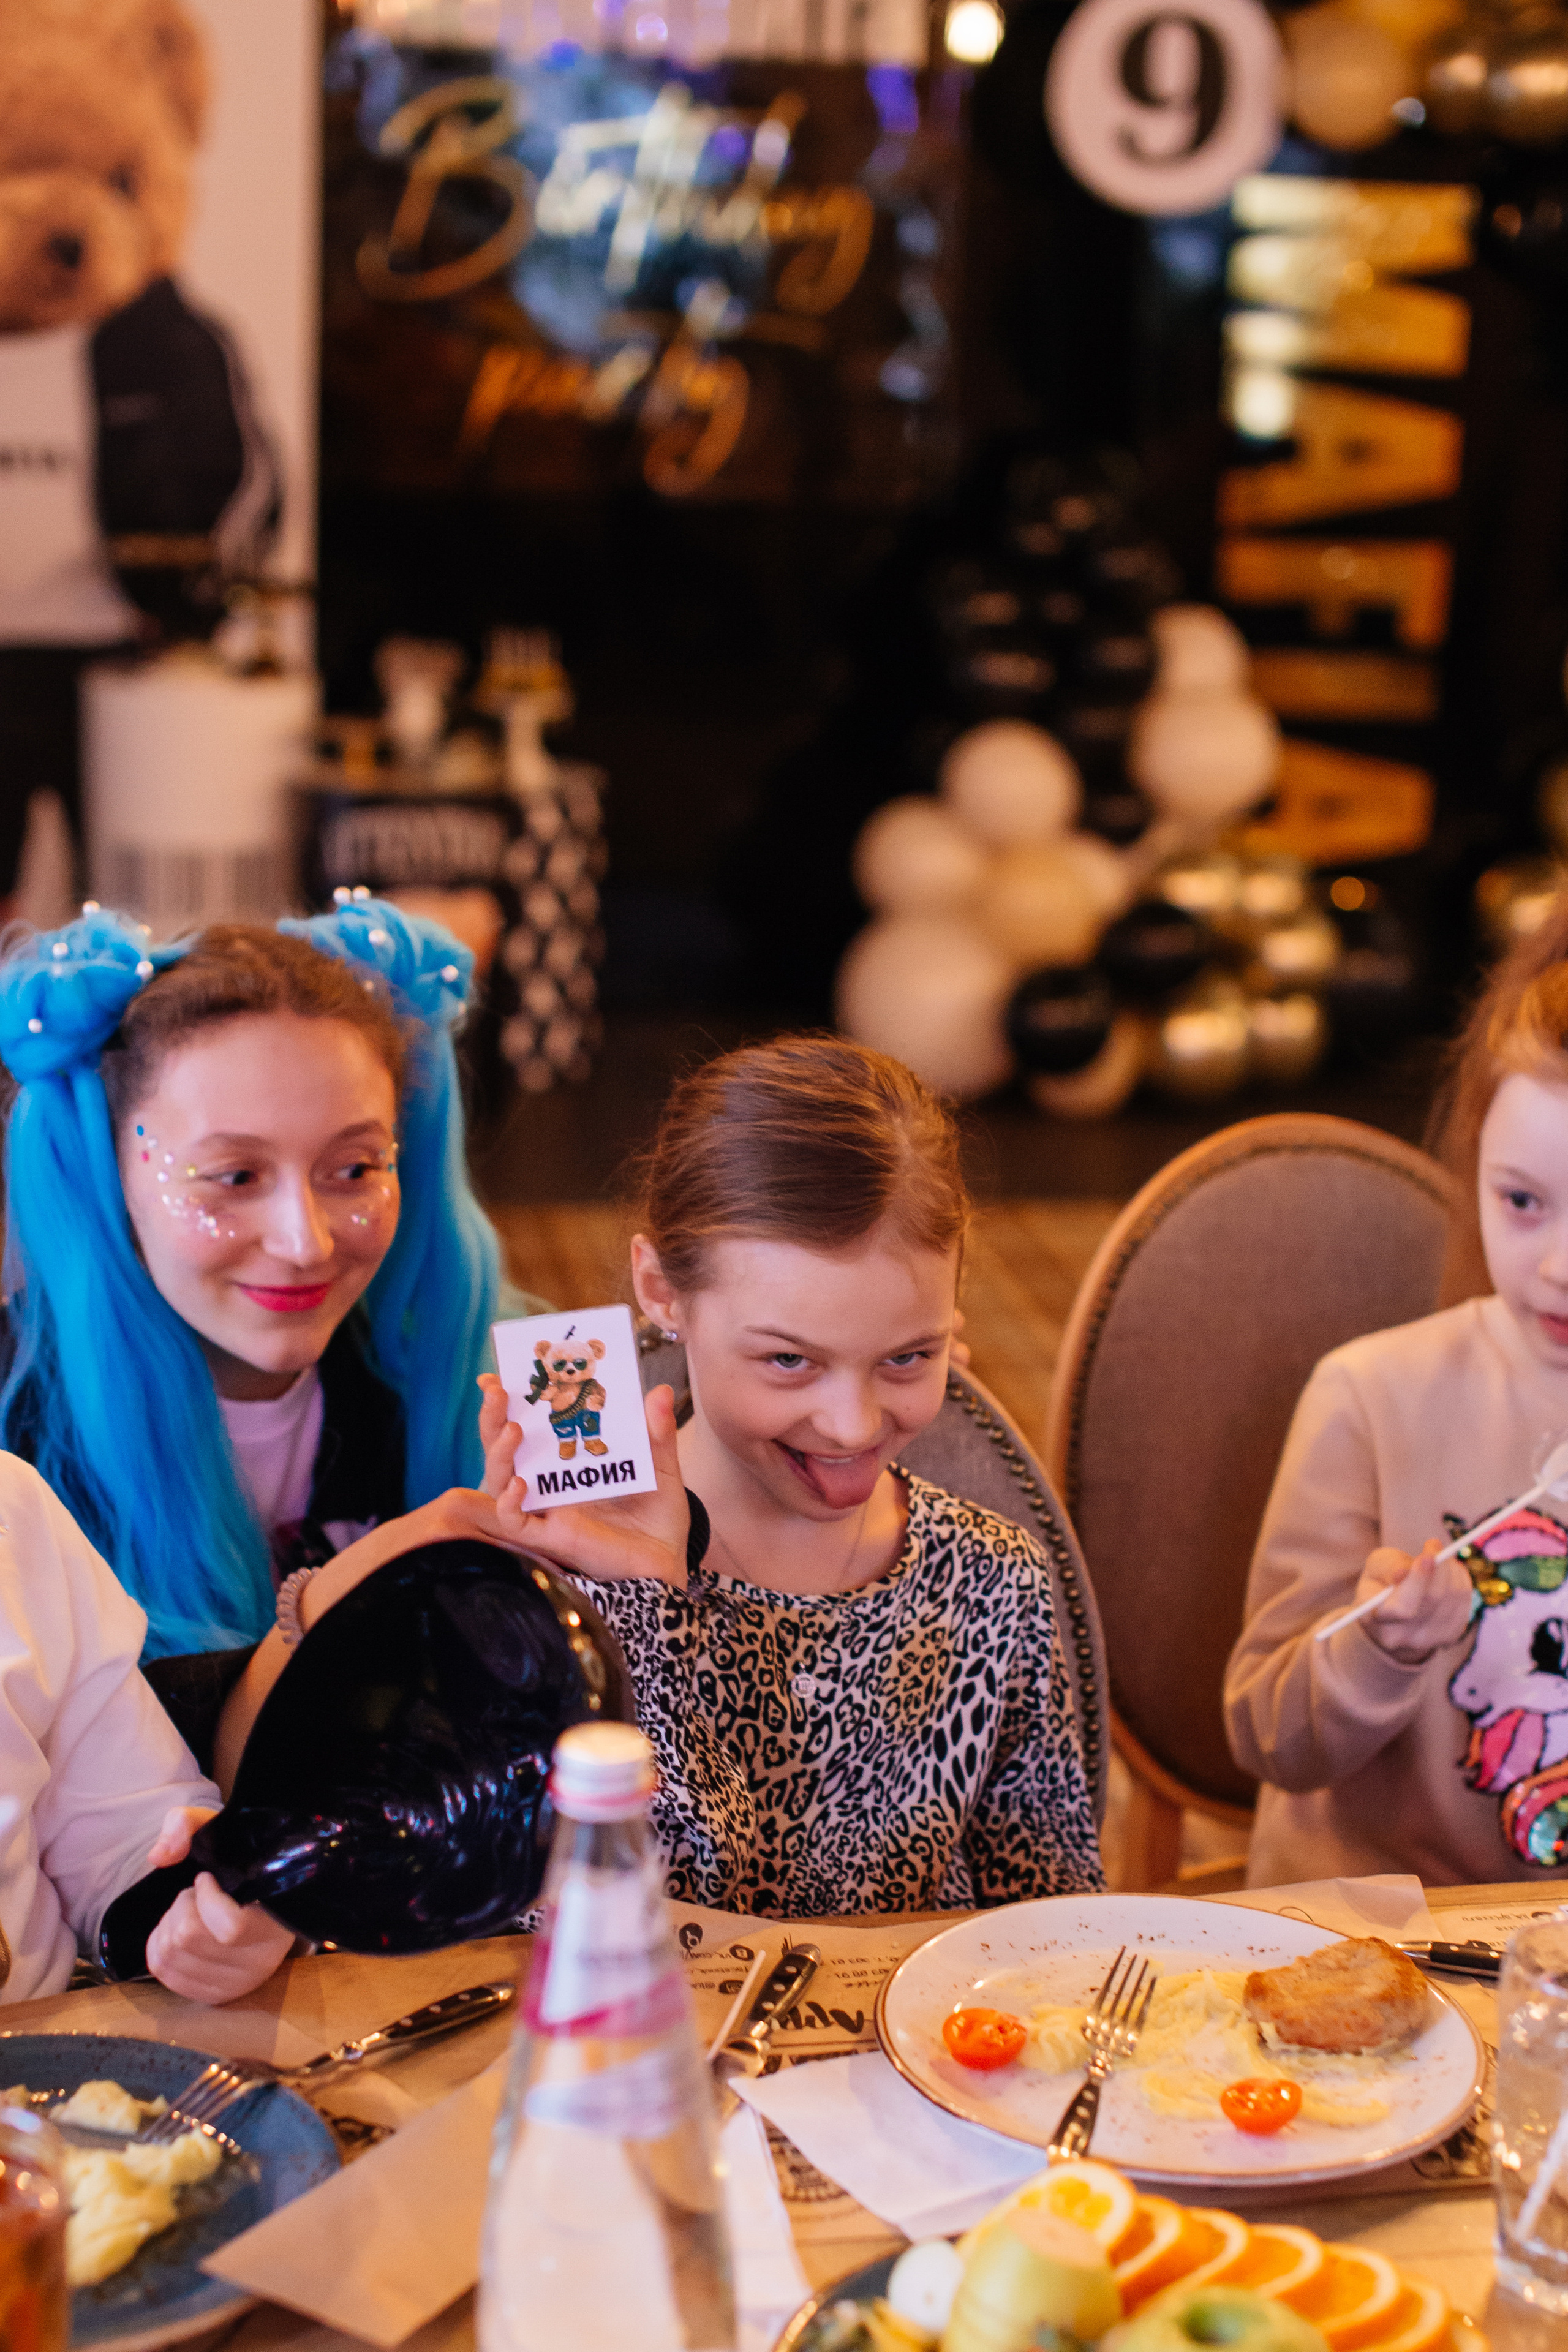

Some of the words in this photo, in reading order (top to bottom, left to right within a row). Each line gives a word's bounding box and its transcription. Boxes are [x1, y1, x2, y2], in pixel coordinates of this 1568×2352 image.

[1118, 12, 1229, 168] 9
[1218, 175, 1476, 862] MAFIA
[536, 1459, 636, 1495] МАФИЯ
